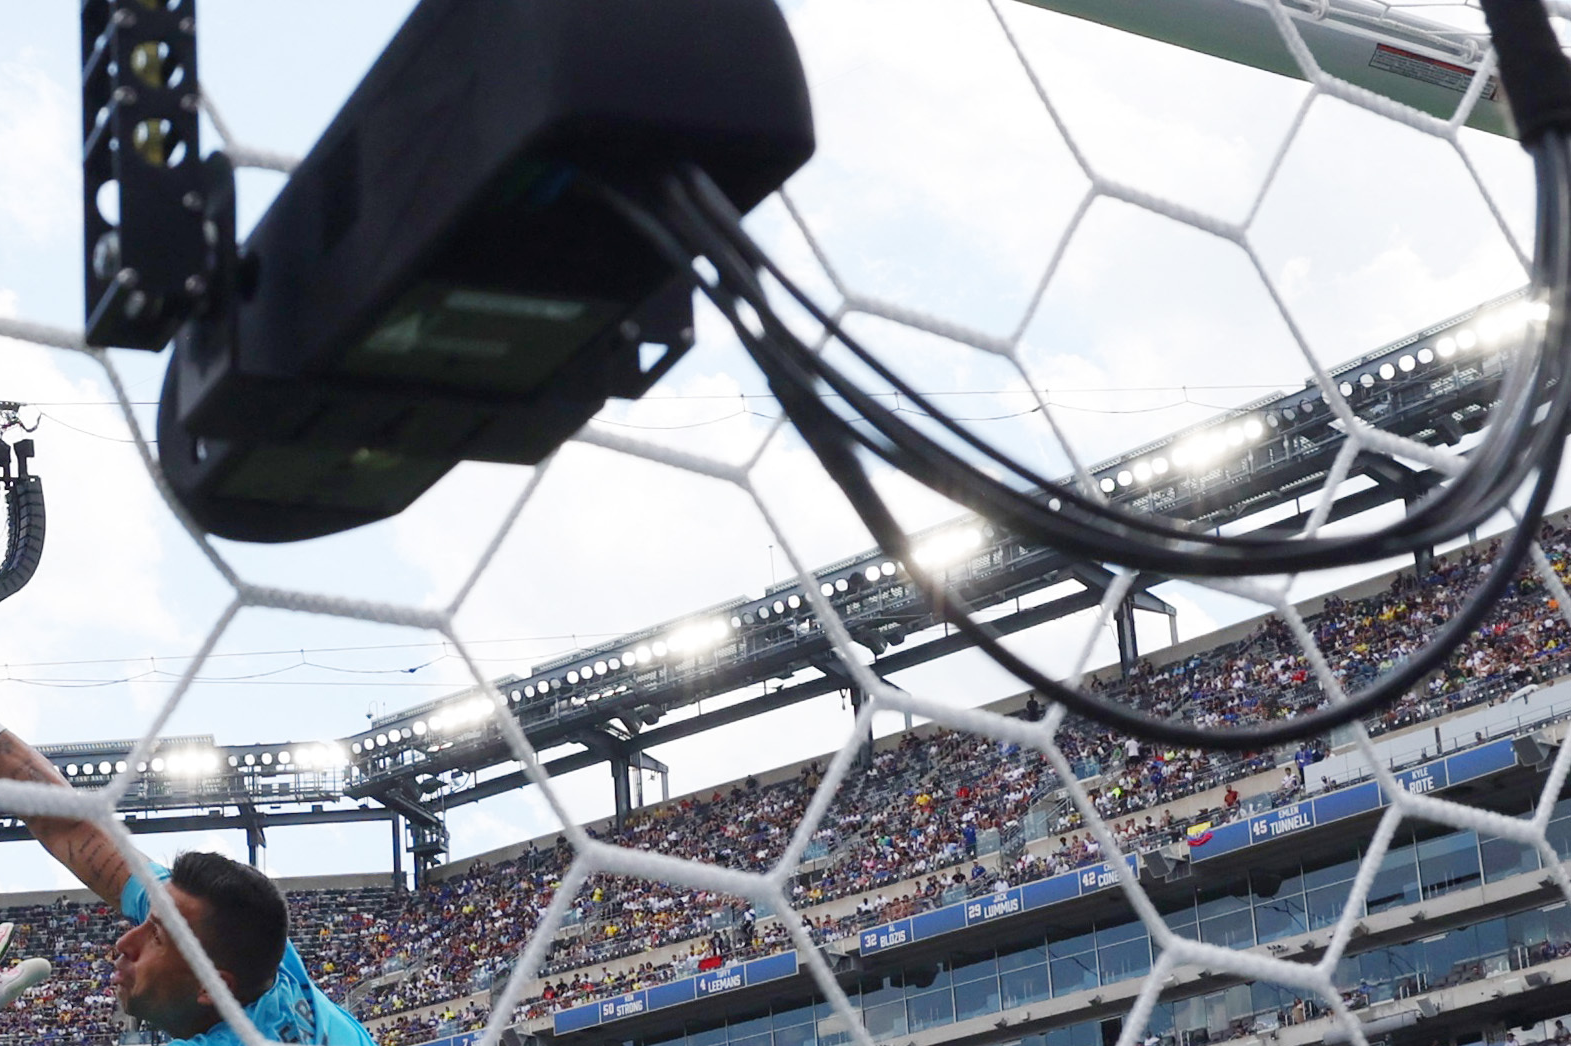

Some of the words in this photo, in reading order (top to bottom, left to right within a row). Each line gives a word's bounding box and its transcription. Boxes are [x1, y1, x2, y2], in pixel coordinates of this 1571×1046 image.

[1412, 766, 1429, 780] KYLE
[1409, 777, 1434, 795] ROTE
[1279, 806, 1299, 820] EMLEN
[1253, 819, 1268, 835] 45
[1269, 812, 1311, 836] TUNNELL
[1082, 872, 1096, 887] 42
[968, 904, 981, 918] 29
[984, 898, 1019, 919] LUMMUS
[864, 935, 877, 948] 32
[880, 931, 906, 947] BLOZIS
[700, 978, 706, 991] 4
[708, 974, 741, 993] LEEMANS
[603, 1003, 615, 1016] 50
[616, 1001, 643, 1016] STRONG
